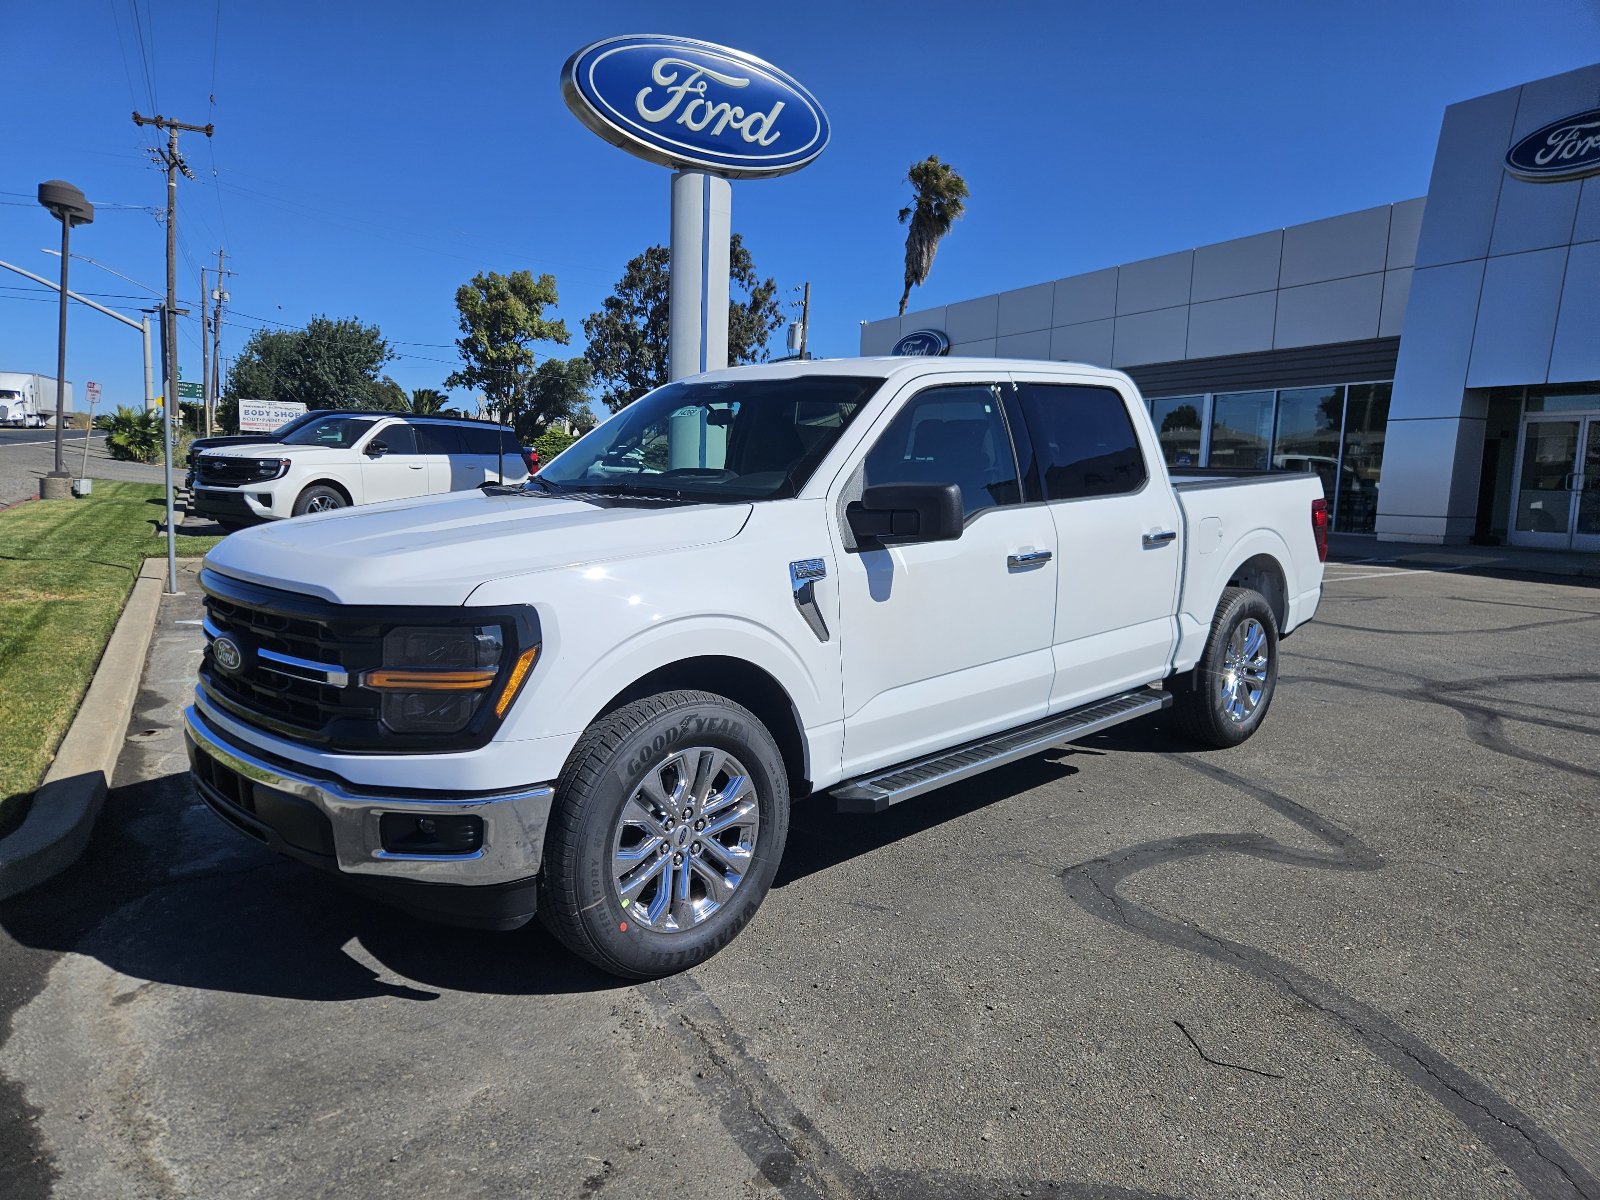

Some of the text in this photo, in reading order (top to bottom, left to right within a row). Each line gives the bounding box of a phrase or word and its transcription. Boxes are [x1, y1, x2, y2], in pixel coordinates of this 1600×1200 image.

[635, 56, 786, 147] Ford
[1534, 121, 1600, 165] For
[244, 409, 301, 420] BODY SHOP
[627, 717, 746, 777] GOODYEAR
